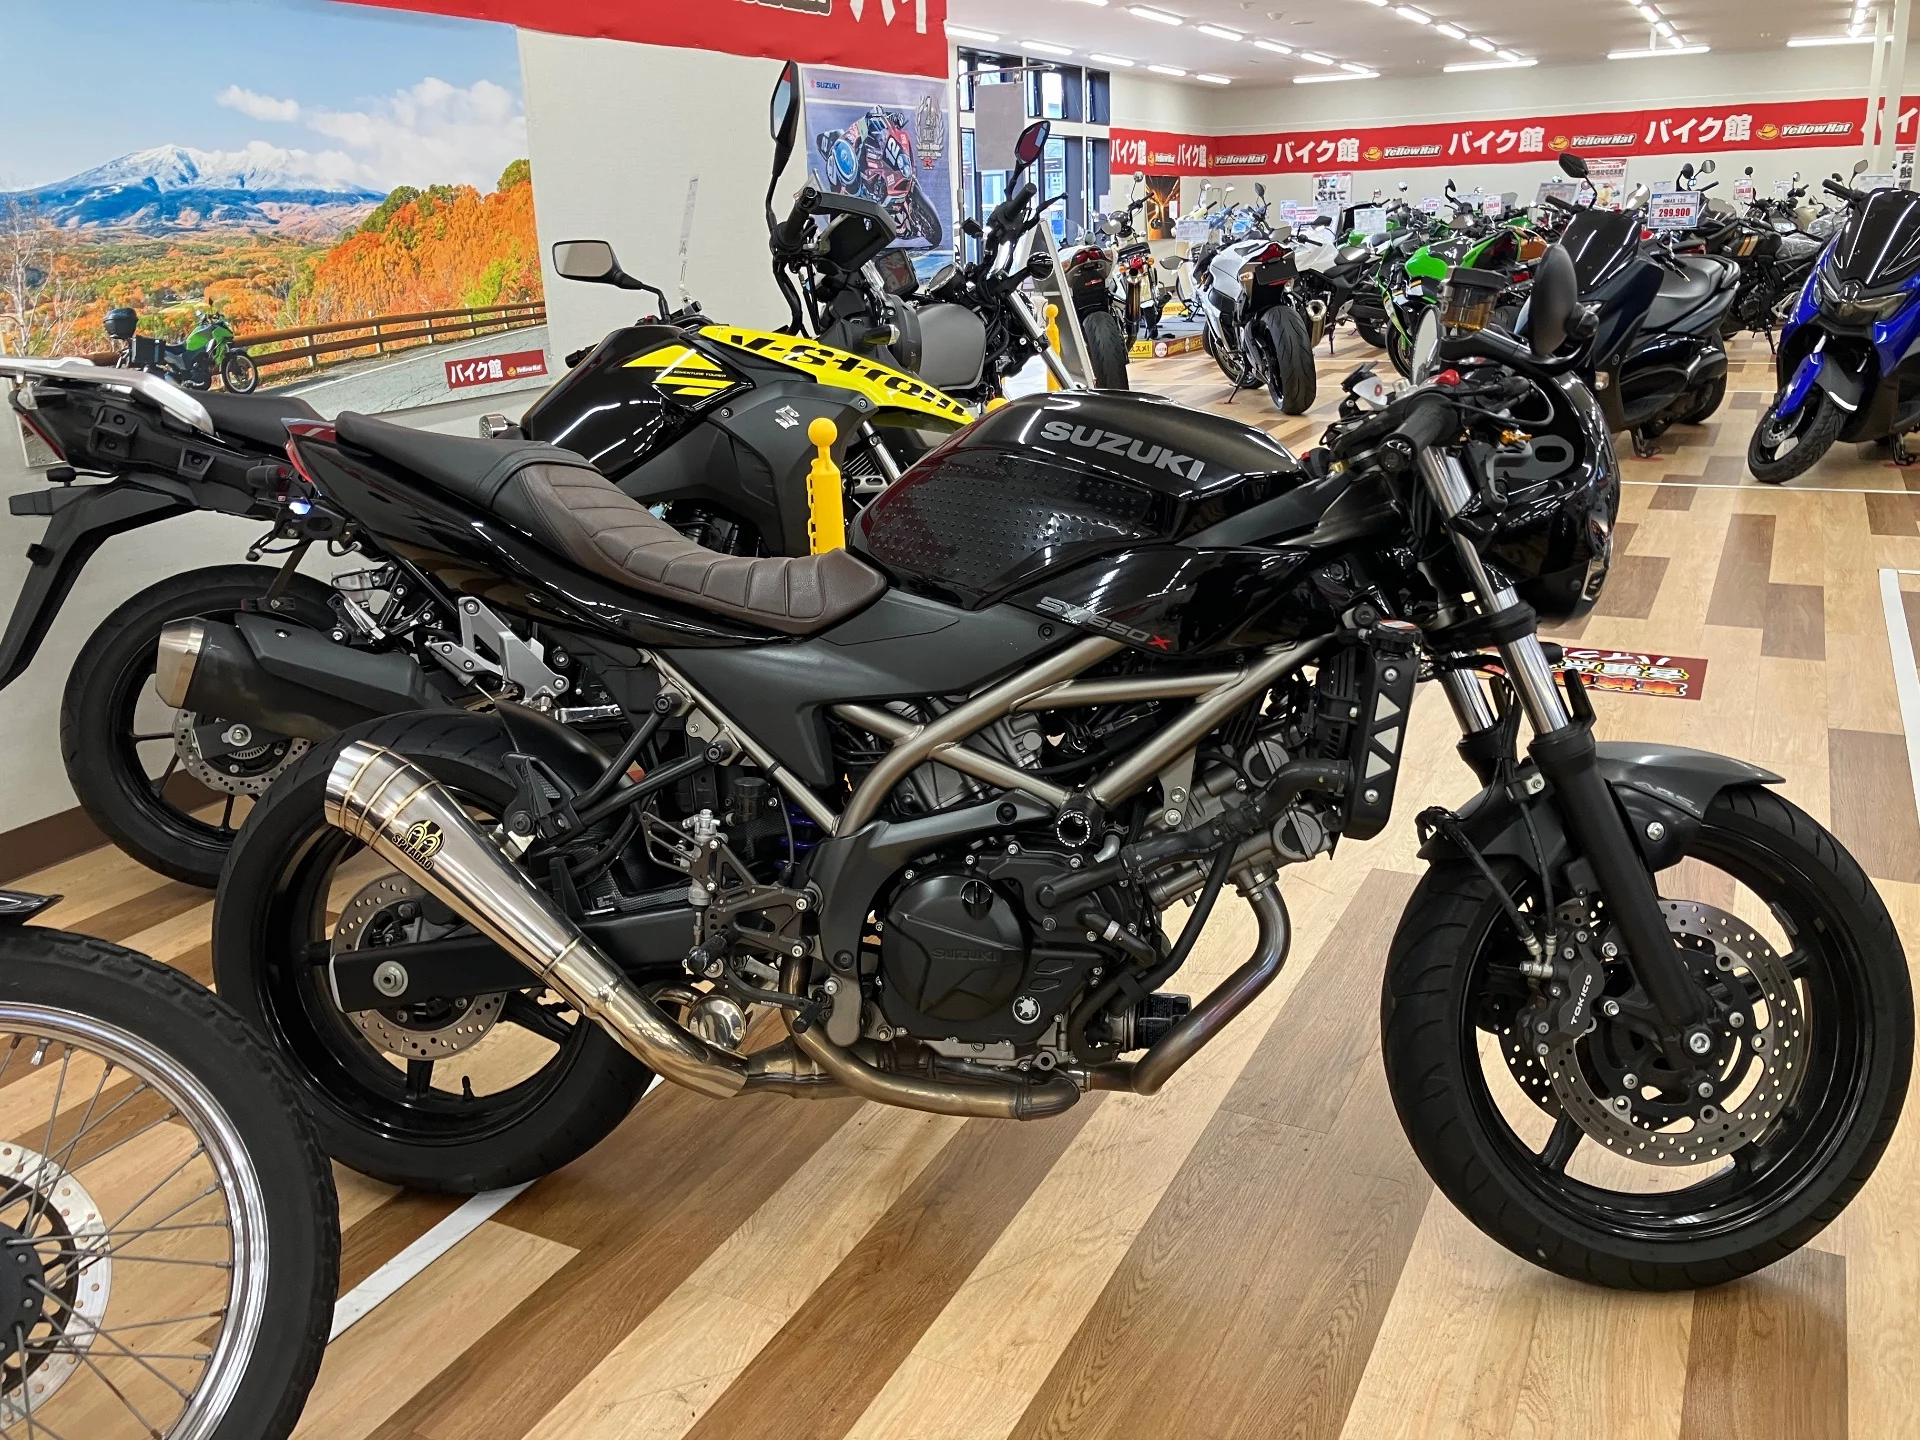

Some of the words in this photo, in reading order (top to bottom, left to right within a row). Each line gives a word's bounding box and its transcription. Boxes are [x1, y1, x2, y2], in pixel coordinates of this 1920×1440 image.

[816, 82, 841, 90] SUZUKI
[1447, 126, 1545, 156] バイク館
[1644, 114, 1753, 145] バイク館
[1111, 138, 1147, 165] バイク館
[1177, 143, 1207, 168] バイク館
[1273, 138, 1360, 164] バイク館
[1659, 208, 1691, 217] 299,900
[451, 359, 503, 384] バイク館
[1041, 421, 1205, 482] SUZUKI
[932, 949, 998, 962] SUZUKI
[1570, 974, 1592, 1025] TOKICO
